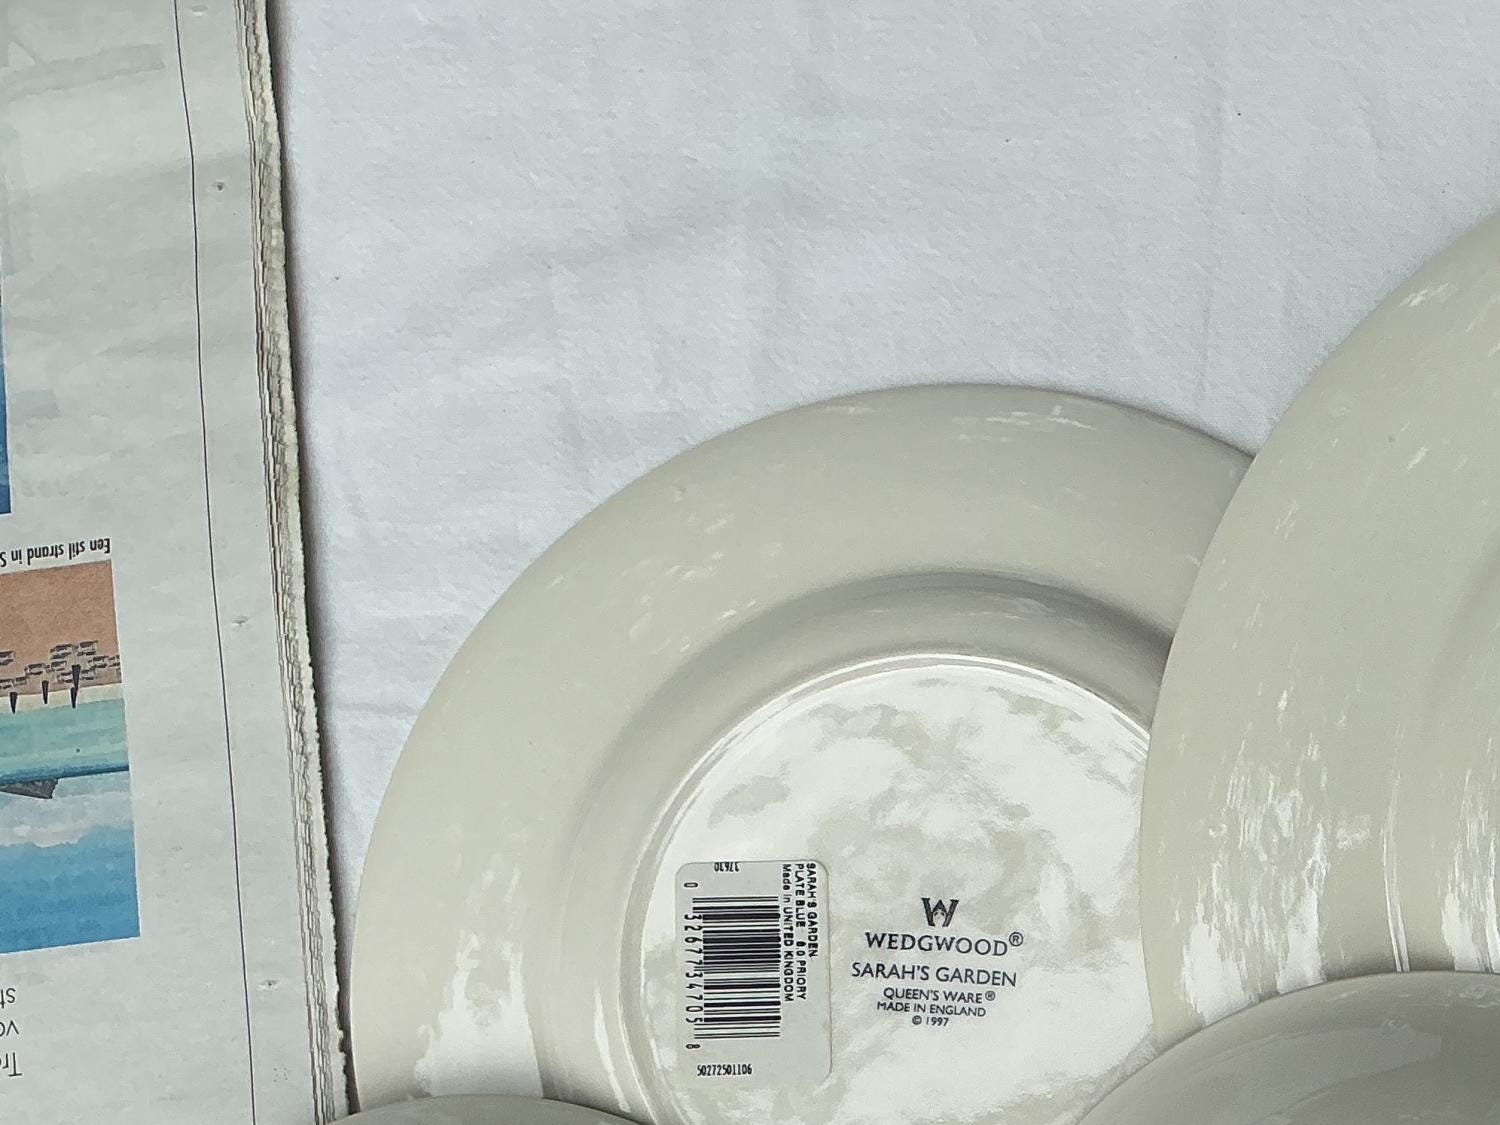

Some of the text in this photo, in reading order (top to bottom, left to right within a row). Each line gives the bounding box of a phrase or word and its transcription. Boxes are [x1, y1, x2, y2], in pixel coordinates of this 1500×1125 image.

[10, 549, 23, 565] in
[26, 543, 65, 566] strand
[68, 540, 86, 561] stil
[89, 537, 111, 554] Een
[794, 863, 805, 897] PLATE
[795, 899, 806, 928] BLUE
[806, 862, 819, 958] SARAH'S GARDEN
[782, 863, 795, 1002] Made in UNITED KINGDOM
[796, 960, 807, 1000] PRIORY
[851, 961, 1017, 988] SARAH'S GARDEN
[883, 987, 940, 1002] QUEEN'S
[876, 1001, 987, 1018] MADE IN ENGLAND
[925, 1016, 950, 1027] 1997
